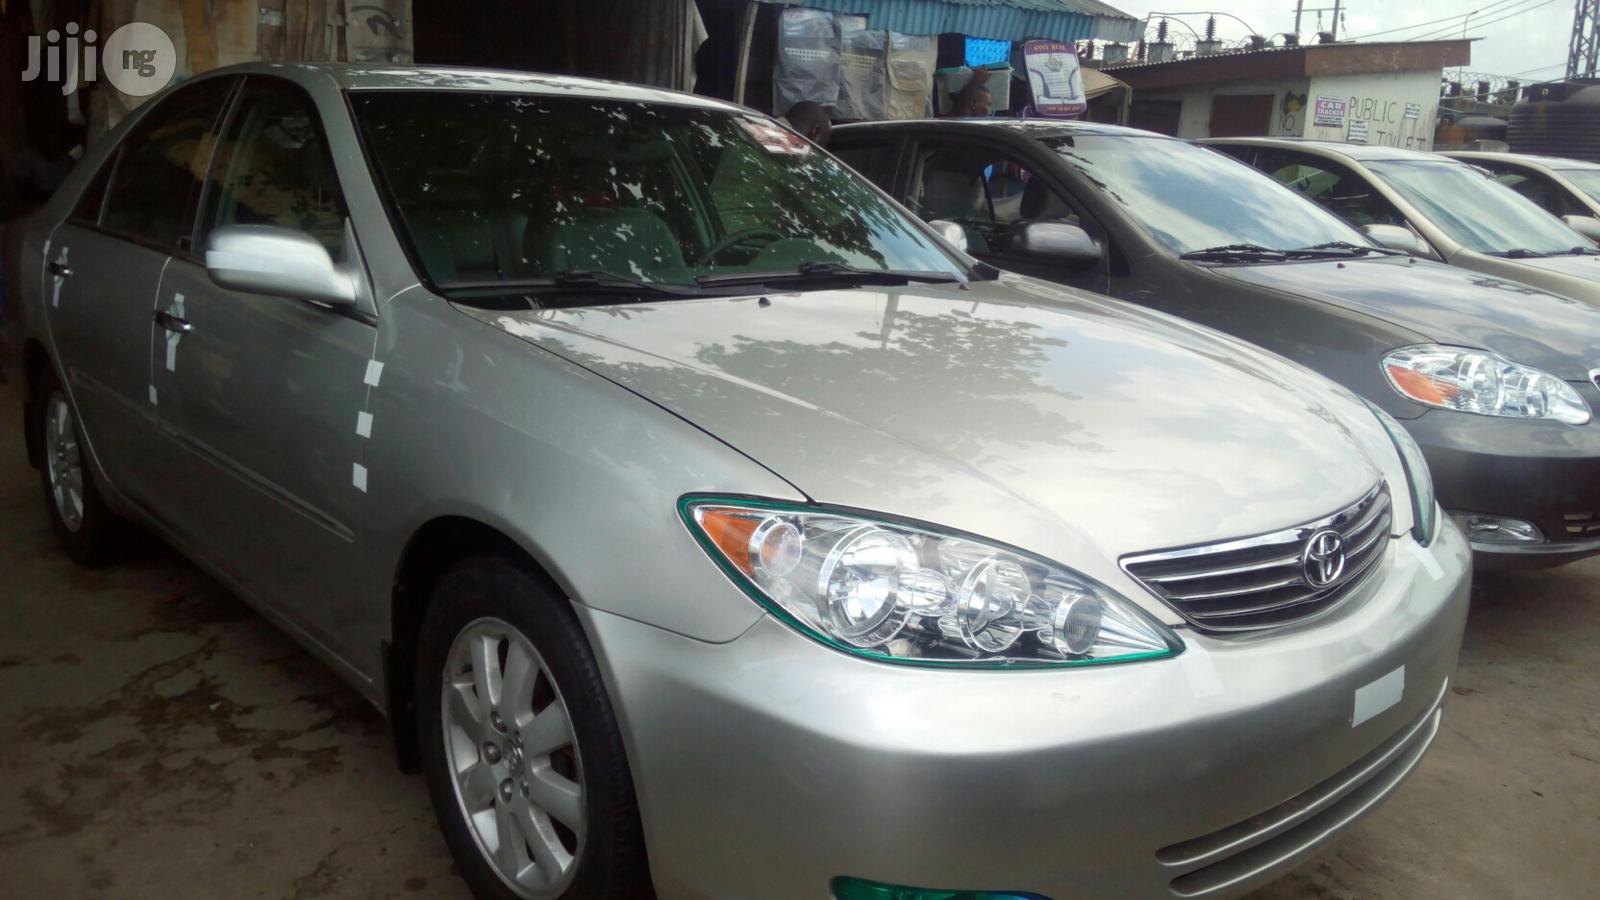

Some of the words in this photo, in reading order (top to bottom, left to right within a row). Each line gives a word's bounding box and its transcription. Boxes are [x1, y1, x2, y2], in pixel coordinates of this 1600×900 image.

[1320, 101, 1342, 110] CAR
[1348, 96, 1397, 123] PUBLIC
[1279, 113, 1296, 131] NO
